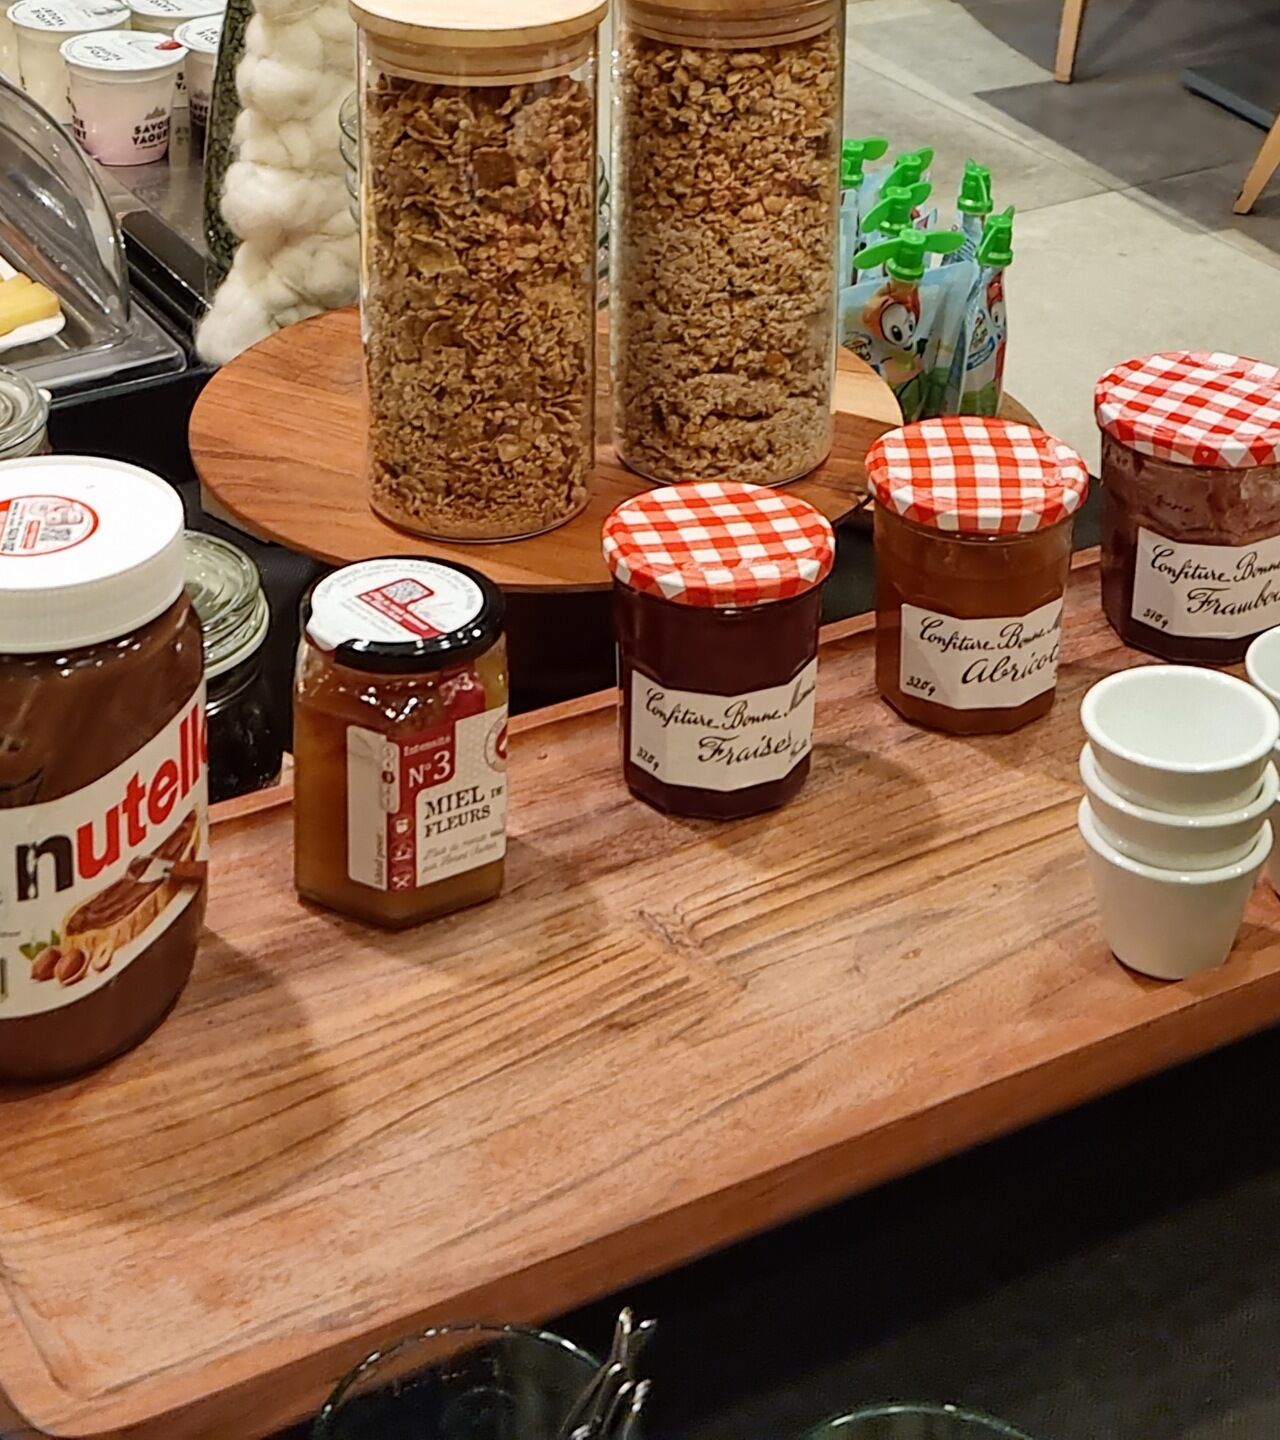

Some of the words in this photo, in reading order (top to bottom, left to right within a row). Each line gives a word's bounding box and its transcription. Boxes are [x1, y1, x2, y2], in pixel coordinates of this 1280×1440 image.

[1150, 544, 1231, 585] Confiture
[919, 616, 996, 653] Confiture
[645, 688, 719, 729] Confiture
[721, 700, 780, 731] Bonne
[424, 785, 485, 820] MIEL
[424, 804, 491, 839] FLEURS
